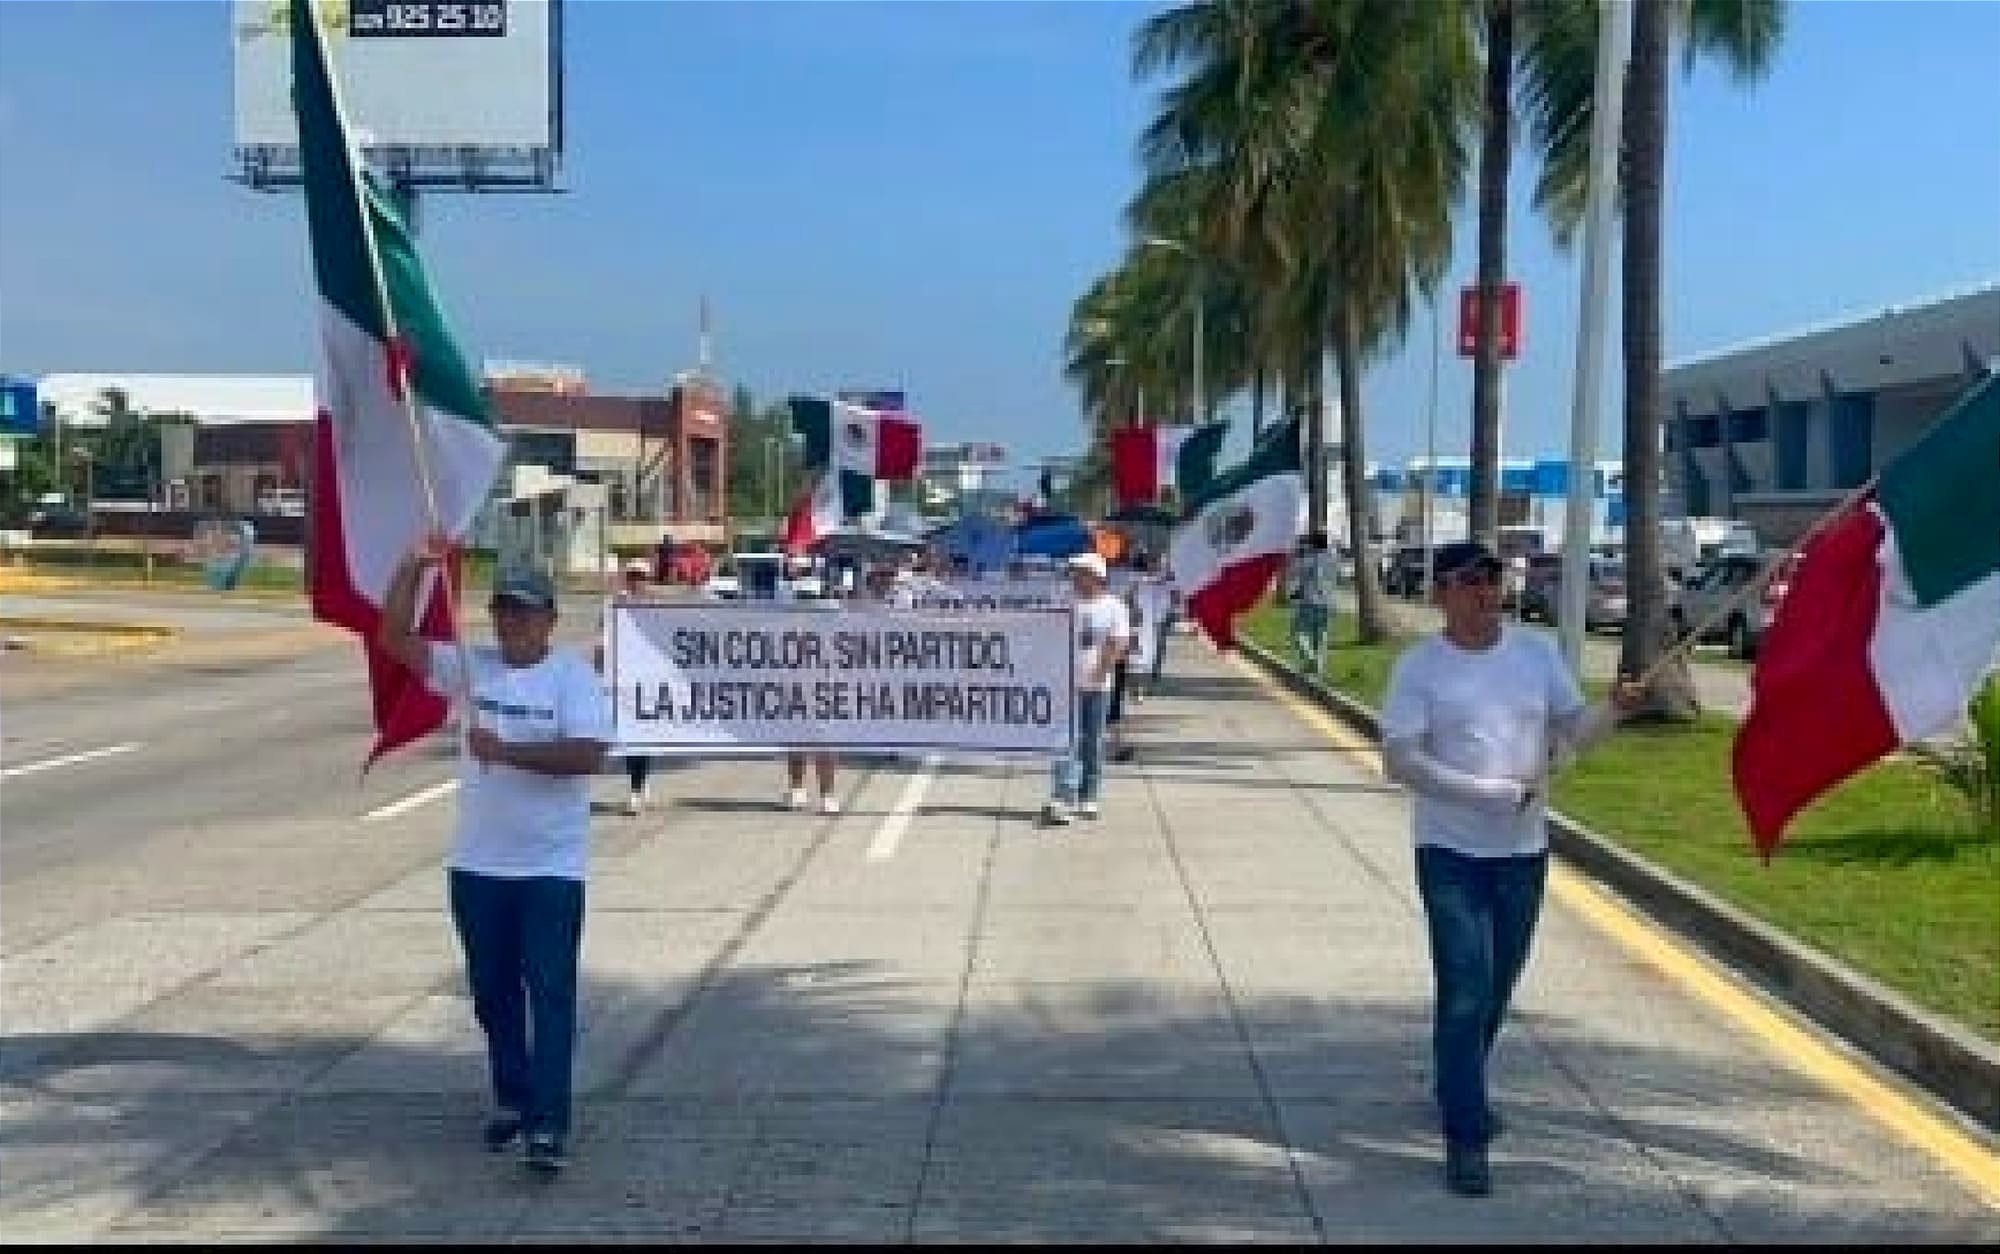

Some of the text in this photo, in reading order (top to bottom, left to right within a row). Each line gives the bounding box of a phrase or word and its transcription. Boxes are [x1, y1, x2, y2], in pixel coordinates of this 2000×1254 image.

[673, 629, 720, 669] SIN
[833, 631, 881, 670] SIN
[884, 631, 1014, 677] PARTIDO,
[635, 682, 1052, 725] LA JUSTICIA SE HA IMPARTIDO
